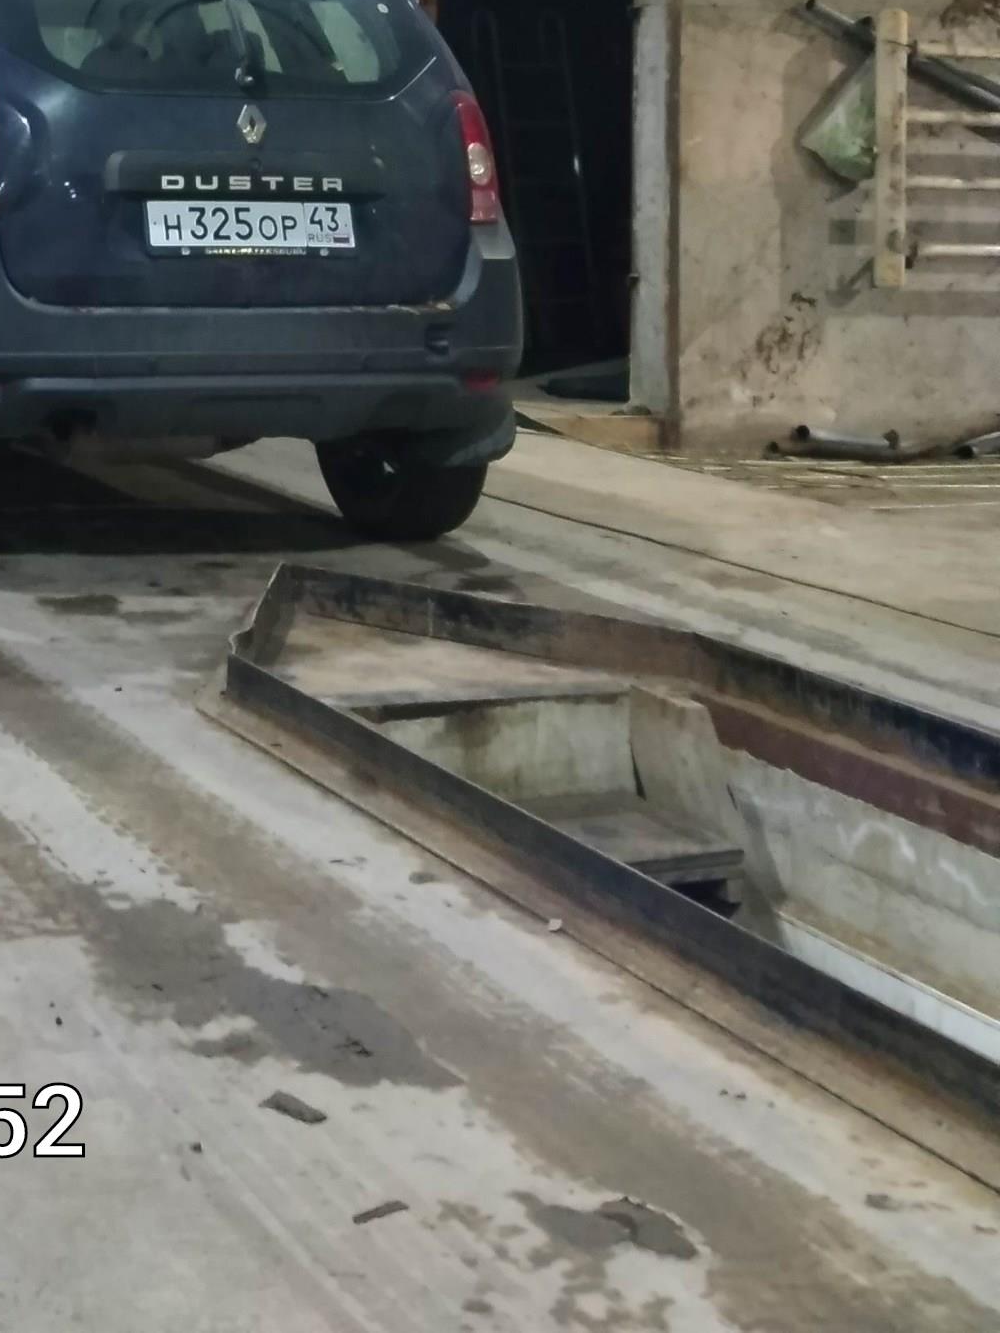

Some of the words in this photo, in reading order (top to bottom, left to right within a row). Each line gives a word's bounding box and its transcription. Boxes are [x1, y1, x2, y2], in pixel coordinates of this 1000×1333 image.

[161, 174, 343, 192] DUSTER
[308, 206, 340, 232] 43
[308, 233, 333, 243] RUS
